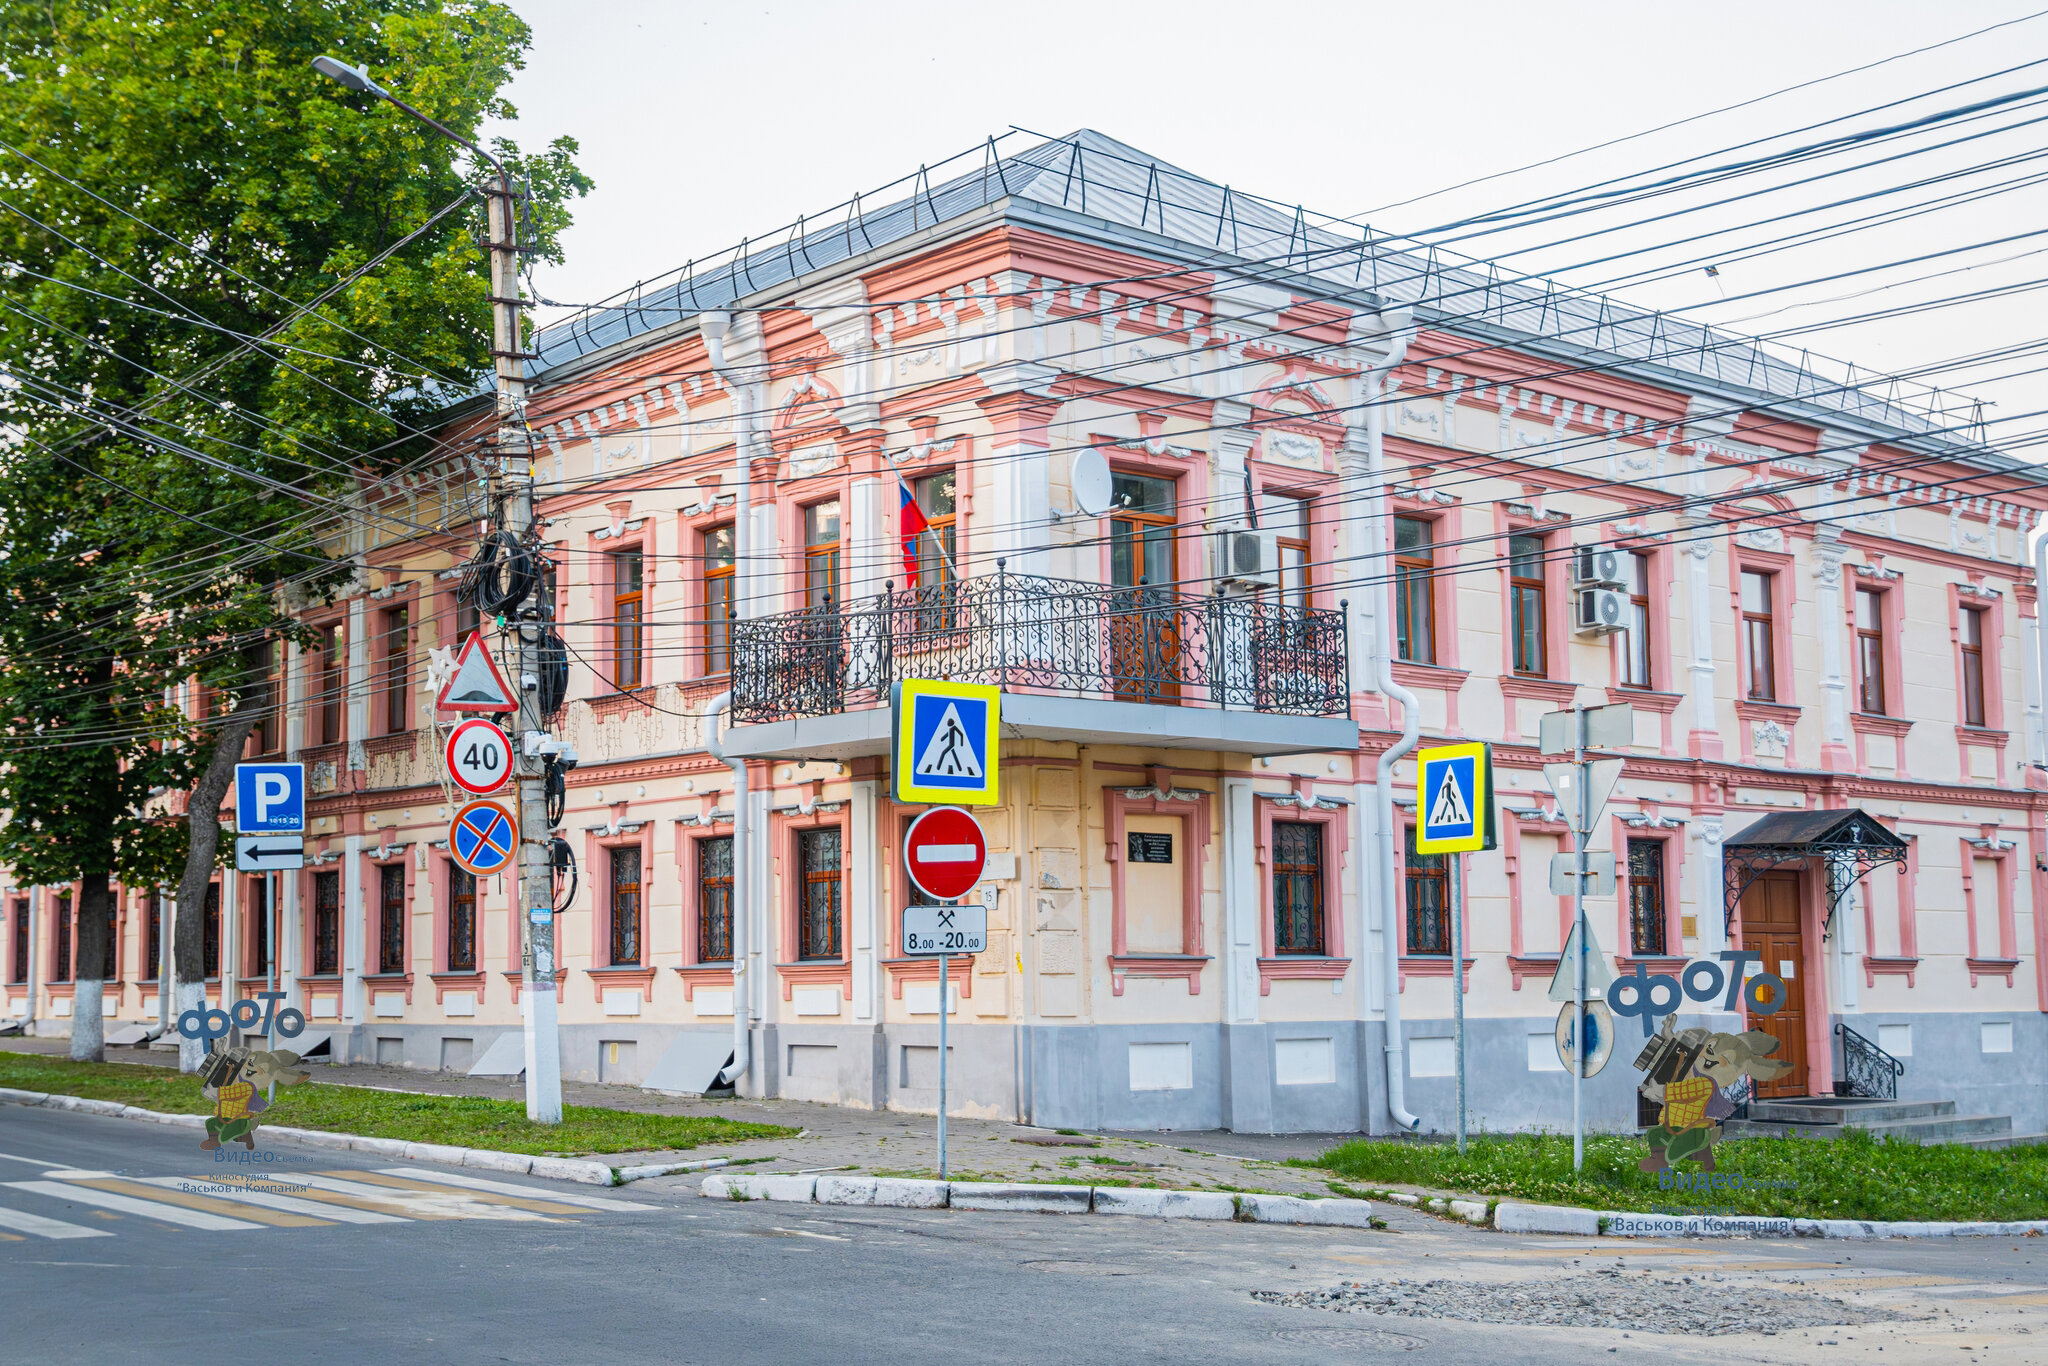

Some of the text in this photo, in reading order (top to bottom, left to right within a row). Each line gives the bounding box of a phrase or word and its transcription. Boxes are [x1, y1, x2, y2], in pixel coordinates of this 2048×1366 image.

[463, 743, 498, 770] 40
[255, 773, 291, 822] P
[909, 933, 934, 949] 8.00
